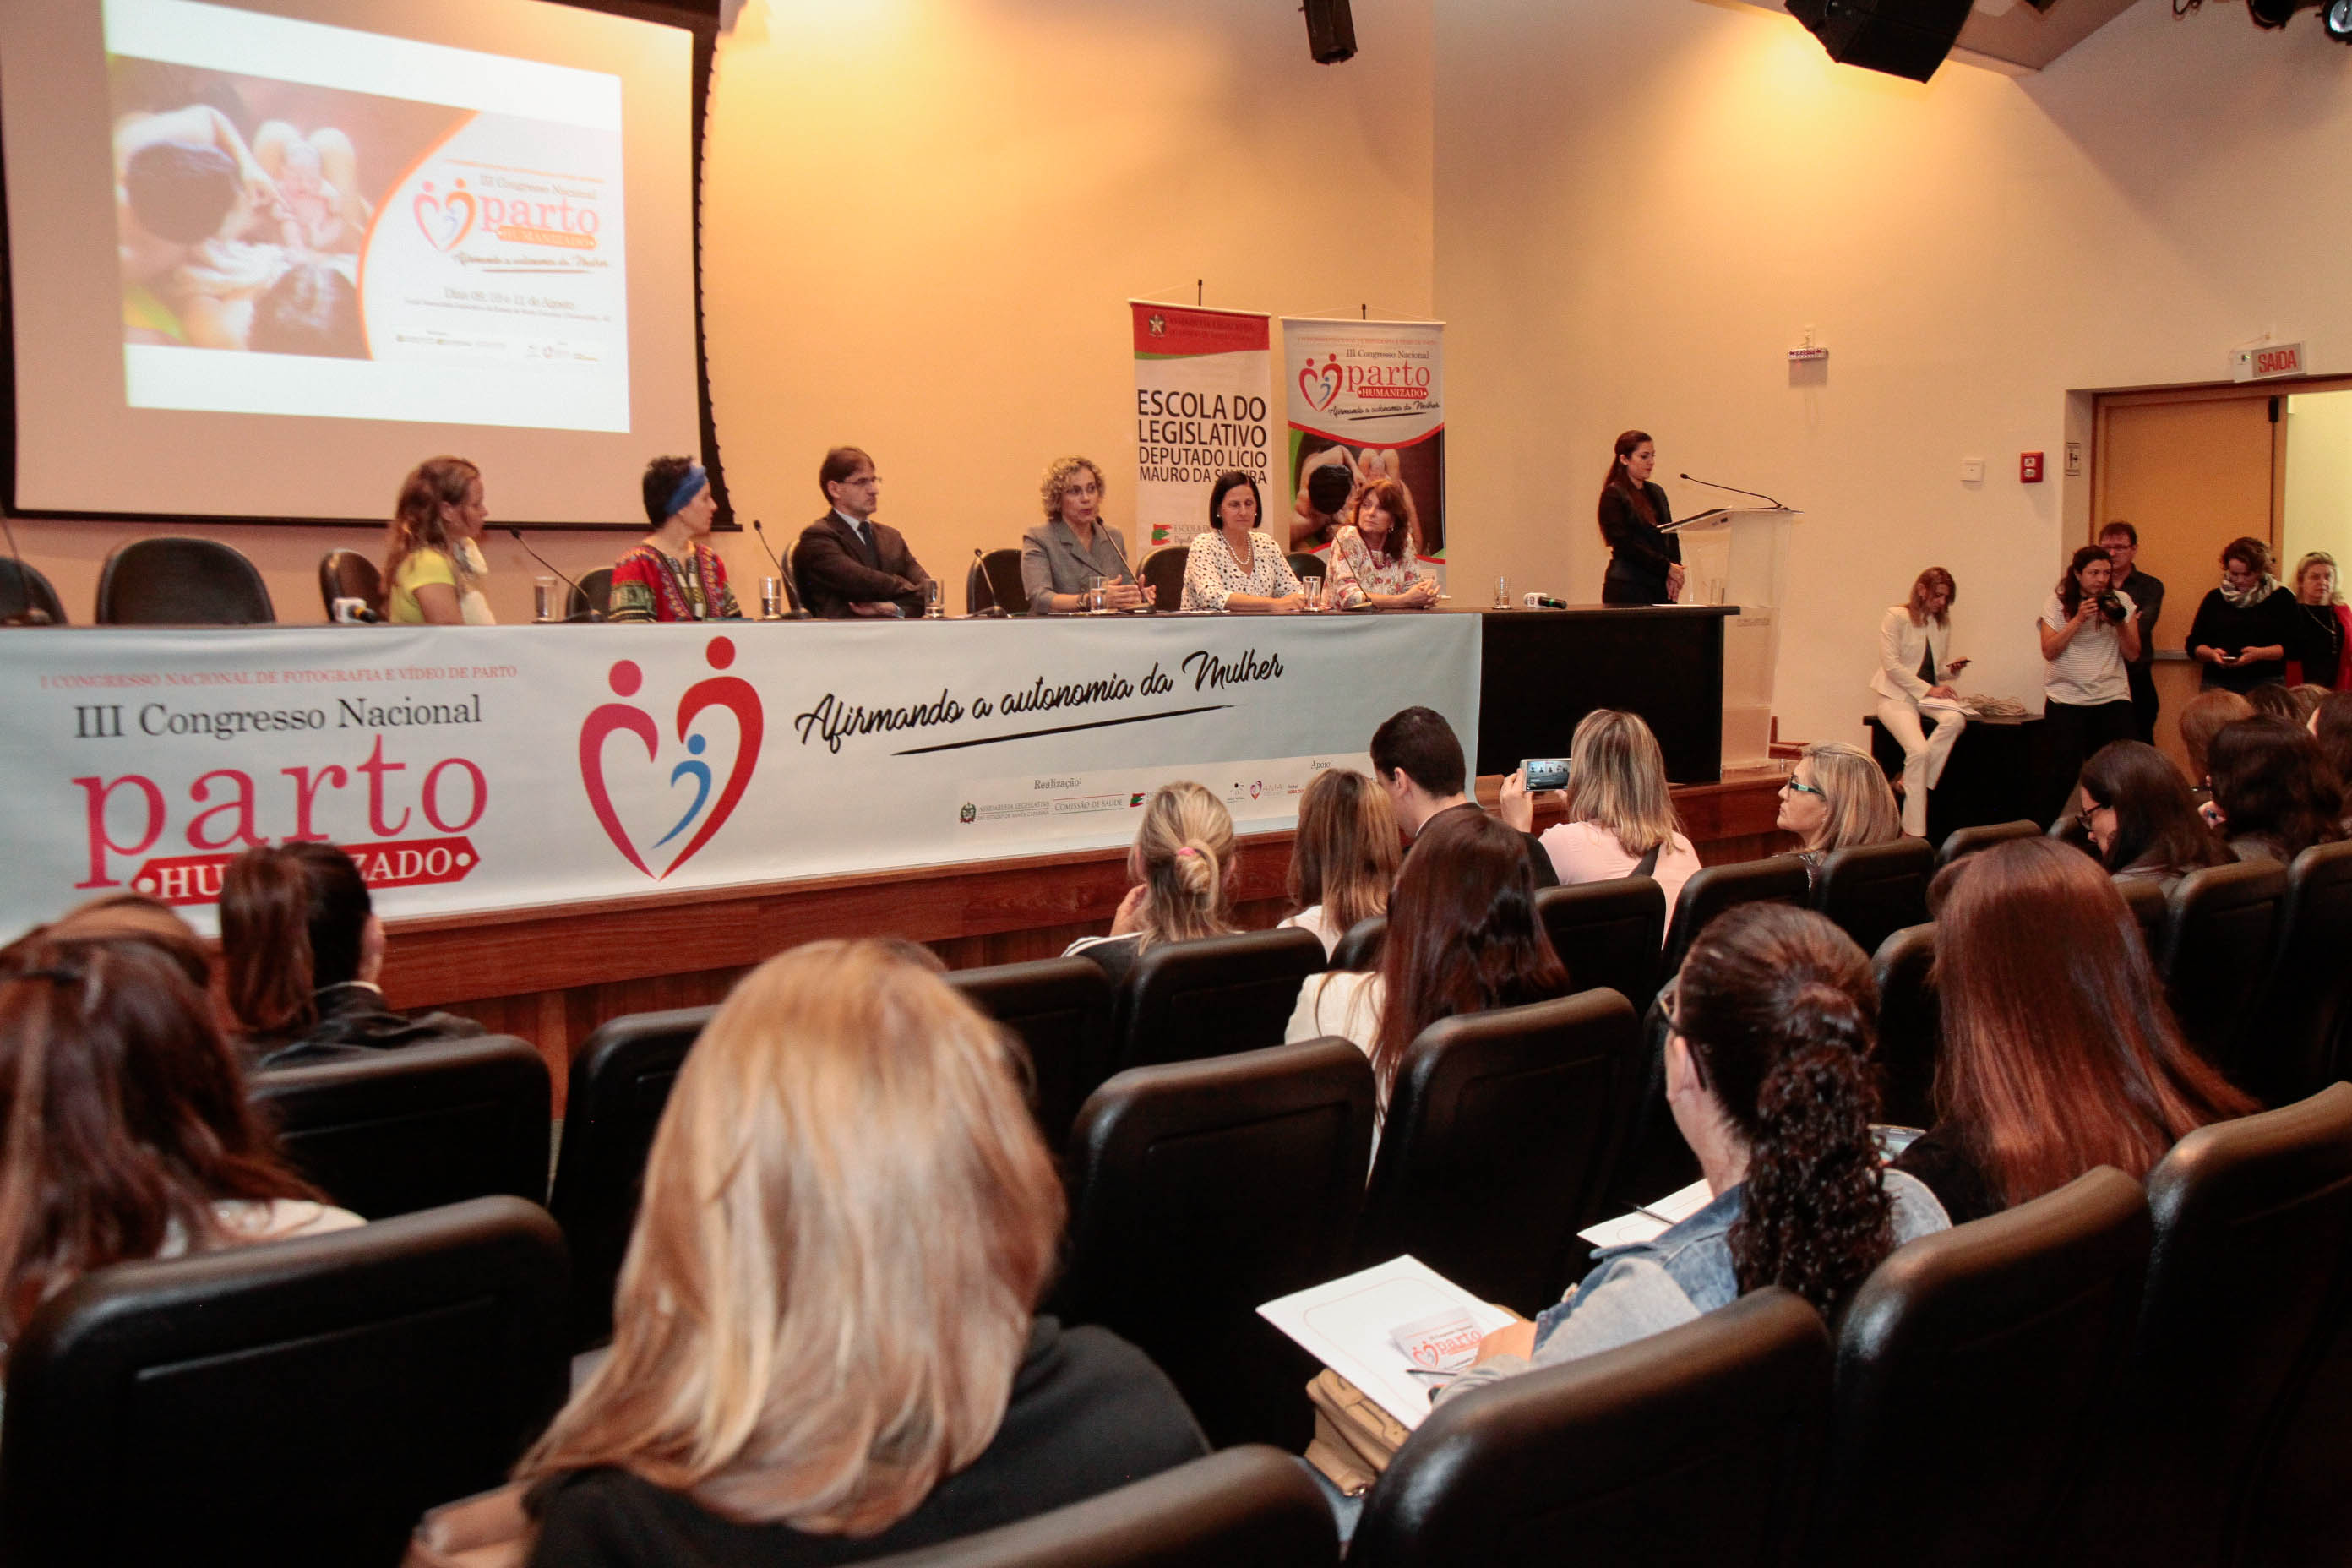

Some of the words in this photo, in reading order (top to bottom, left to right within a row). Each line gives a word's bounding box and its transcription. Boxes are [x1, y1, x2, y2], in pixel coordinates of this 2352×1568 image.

[478, 196, 600, 236] parto
[1346, 349, 1356, 358] III
[1358, 350, 1396, 360] Congresso
[1397, 351, 1429, 359] Nacional
[1346, 359, 1431, 393] parto
[1137, 389, 1227, 420] ESCOLA
[1233, 395, 1266, 422] DO
[1362, 388, 1424, 398] HUMANIZADO
[1138, 419, 1267, 448] LEGISLATIVO
[1139, 446, 1225, 467] DEPUTADO
[1228, 446, 1267, 468] LÍCIO
[1140, 466, 1190, 482] MAURO
[1193, 467, 1211, 483] DA
[53, 673, 161, 689] CONGRESSO
[165, 672, 252, 686] NACIONAL
[256, 671, 278, 684] DE
[283, 668, 384, 683] FOTOGRAFIA
[385, 668, 394, 680] E
[398, 665, 446, 680] VÍDEO
[449, 666, 467, 679] DE
[472, 665, 518, 678] PARTO
[795, 688, 964, 754] Afirmando
[972, 697, 993, 720] a
[1000, 672, 1134, 717] autonomia
[1139, 661, 1174, 696] da
[1181, 648, 1284, 692] Mulher
[74, 705, 126, 739] III
[139, 701, 326, 741] Congresso
[336, 694, 483, 730] Nacional
[1034, 777, 1082, 791] Realização:
[70, 732, 488, 890] parto
[1054, 799, 1091, 812] COMISSÃO
[158, 847, 454, 900] HUZADO
[1435, 1331, 1482, 1354] parto
